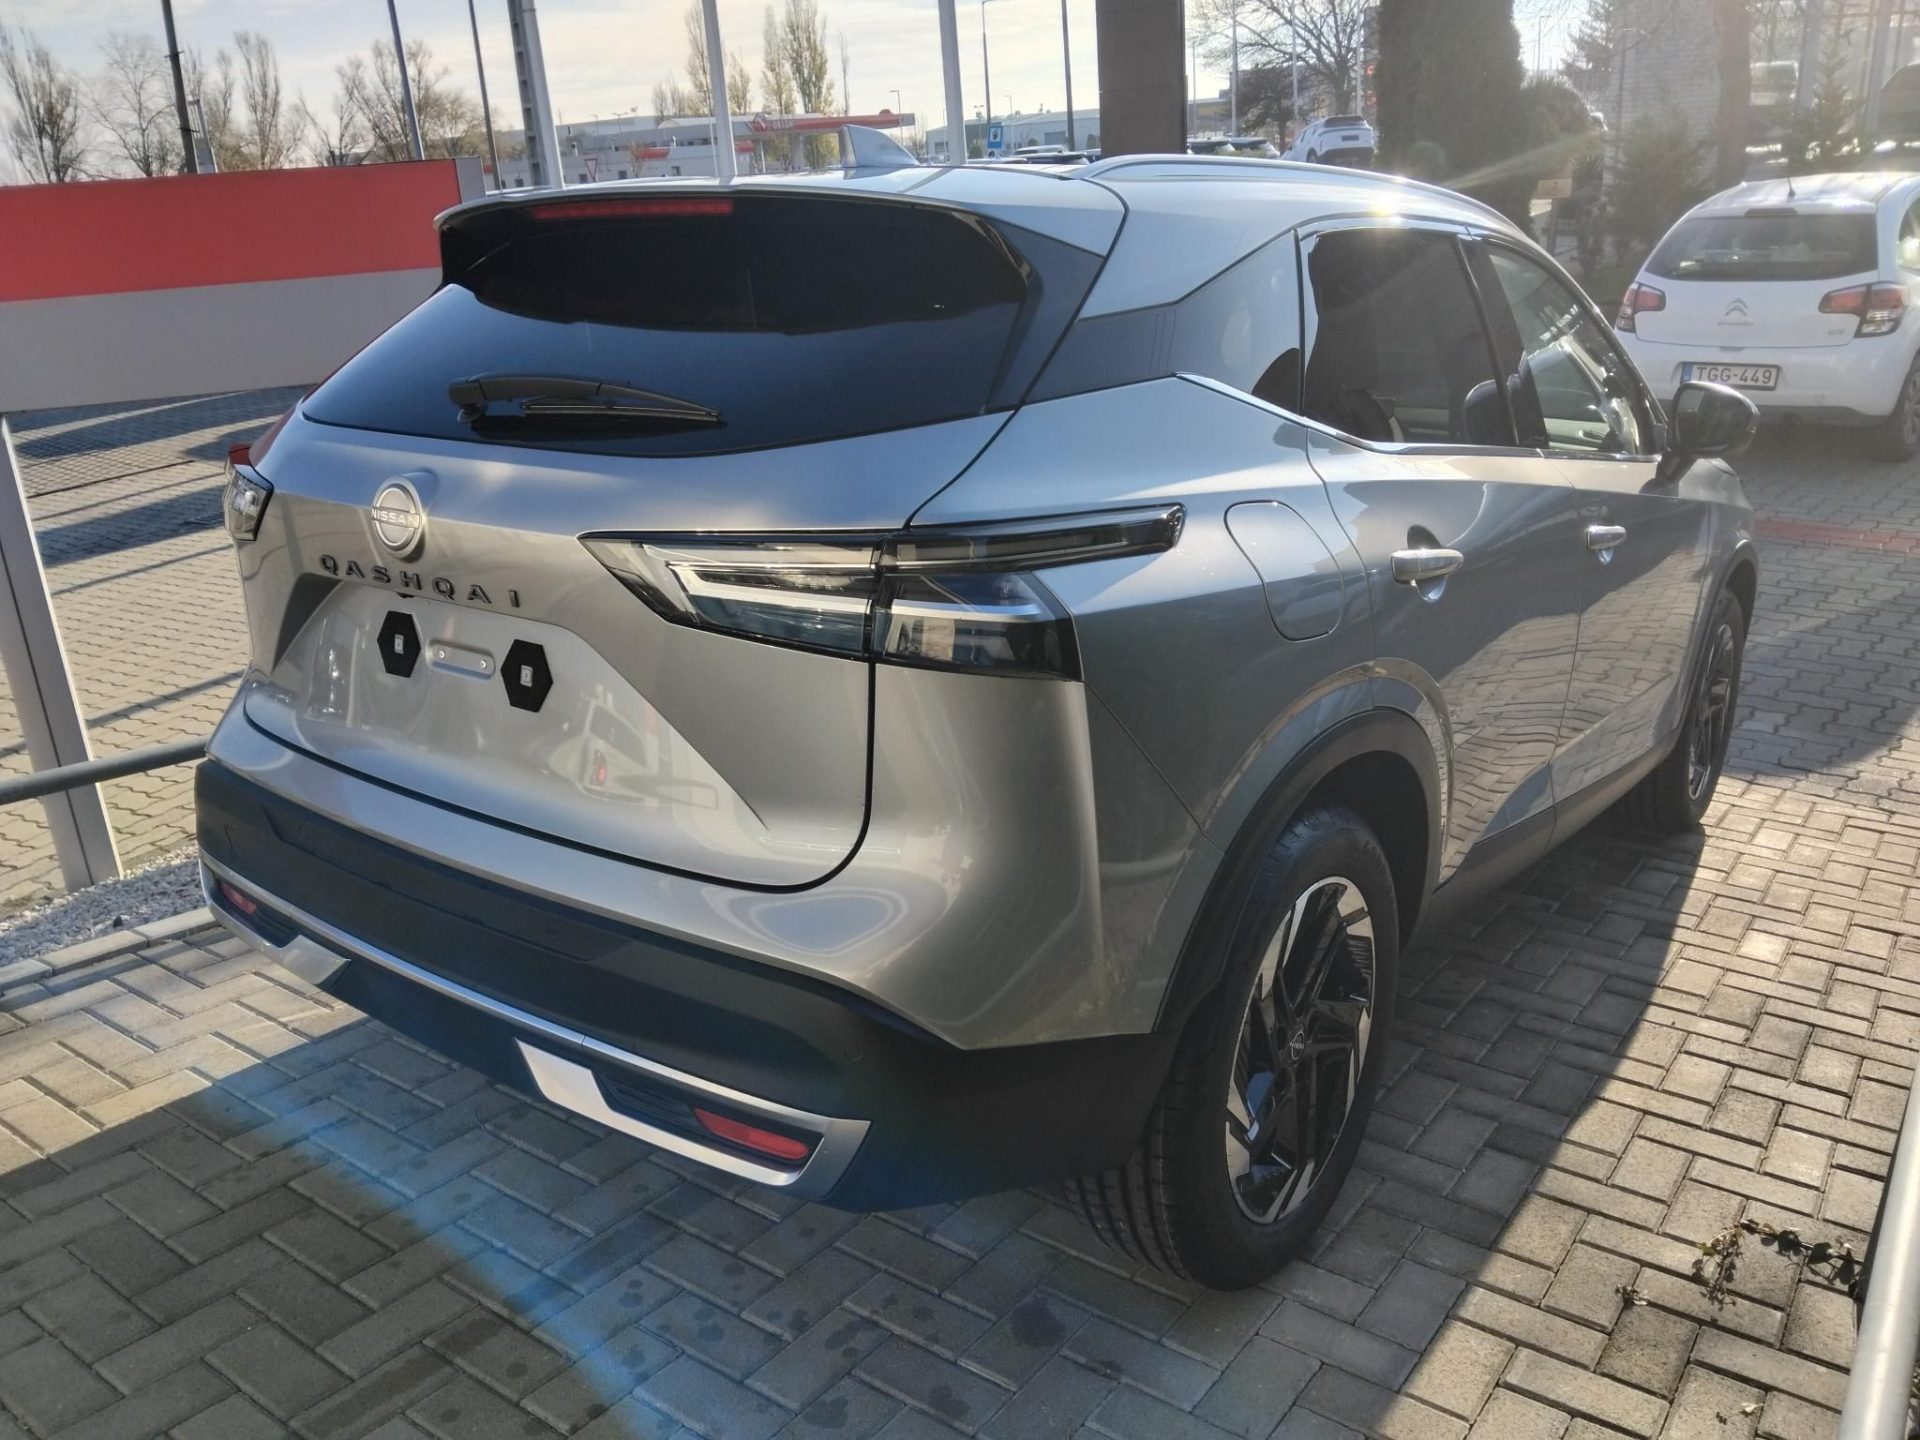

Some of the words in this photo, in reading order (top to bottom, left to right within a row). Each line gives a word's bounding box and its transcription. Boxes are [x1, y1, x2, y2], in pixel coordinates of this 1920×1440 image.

[1696, 366, 1773, 385] TGG-449
[371, 507, 419, 528] NISSAN
[319, 554, 521, 608] QASHQAI
